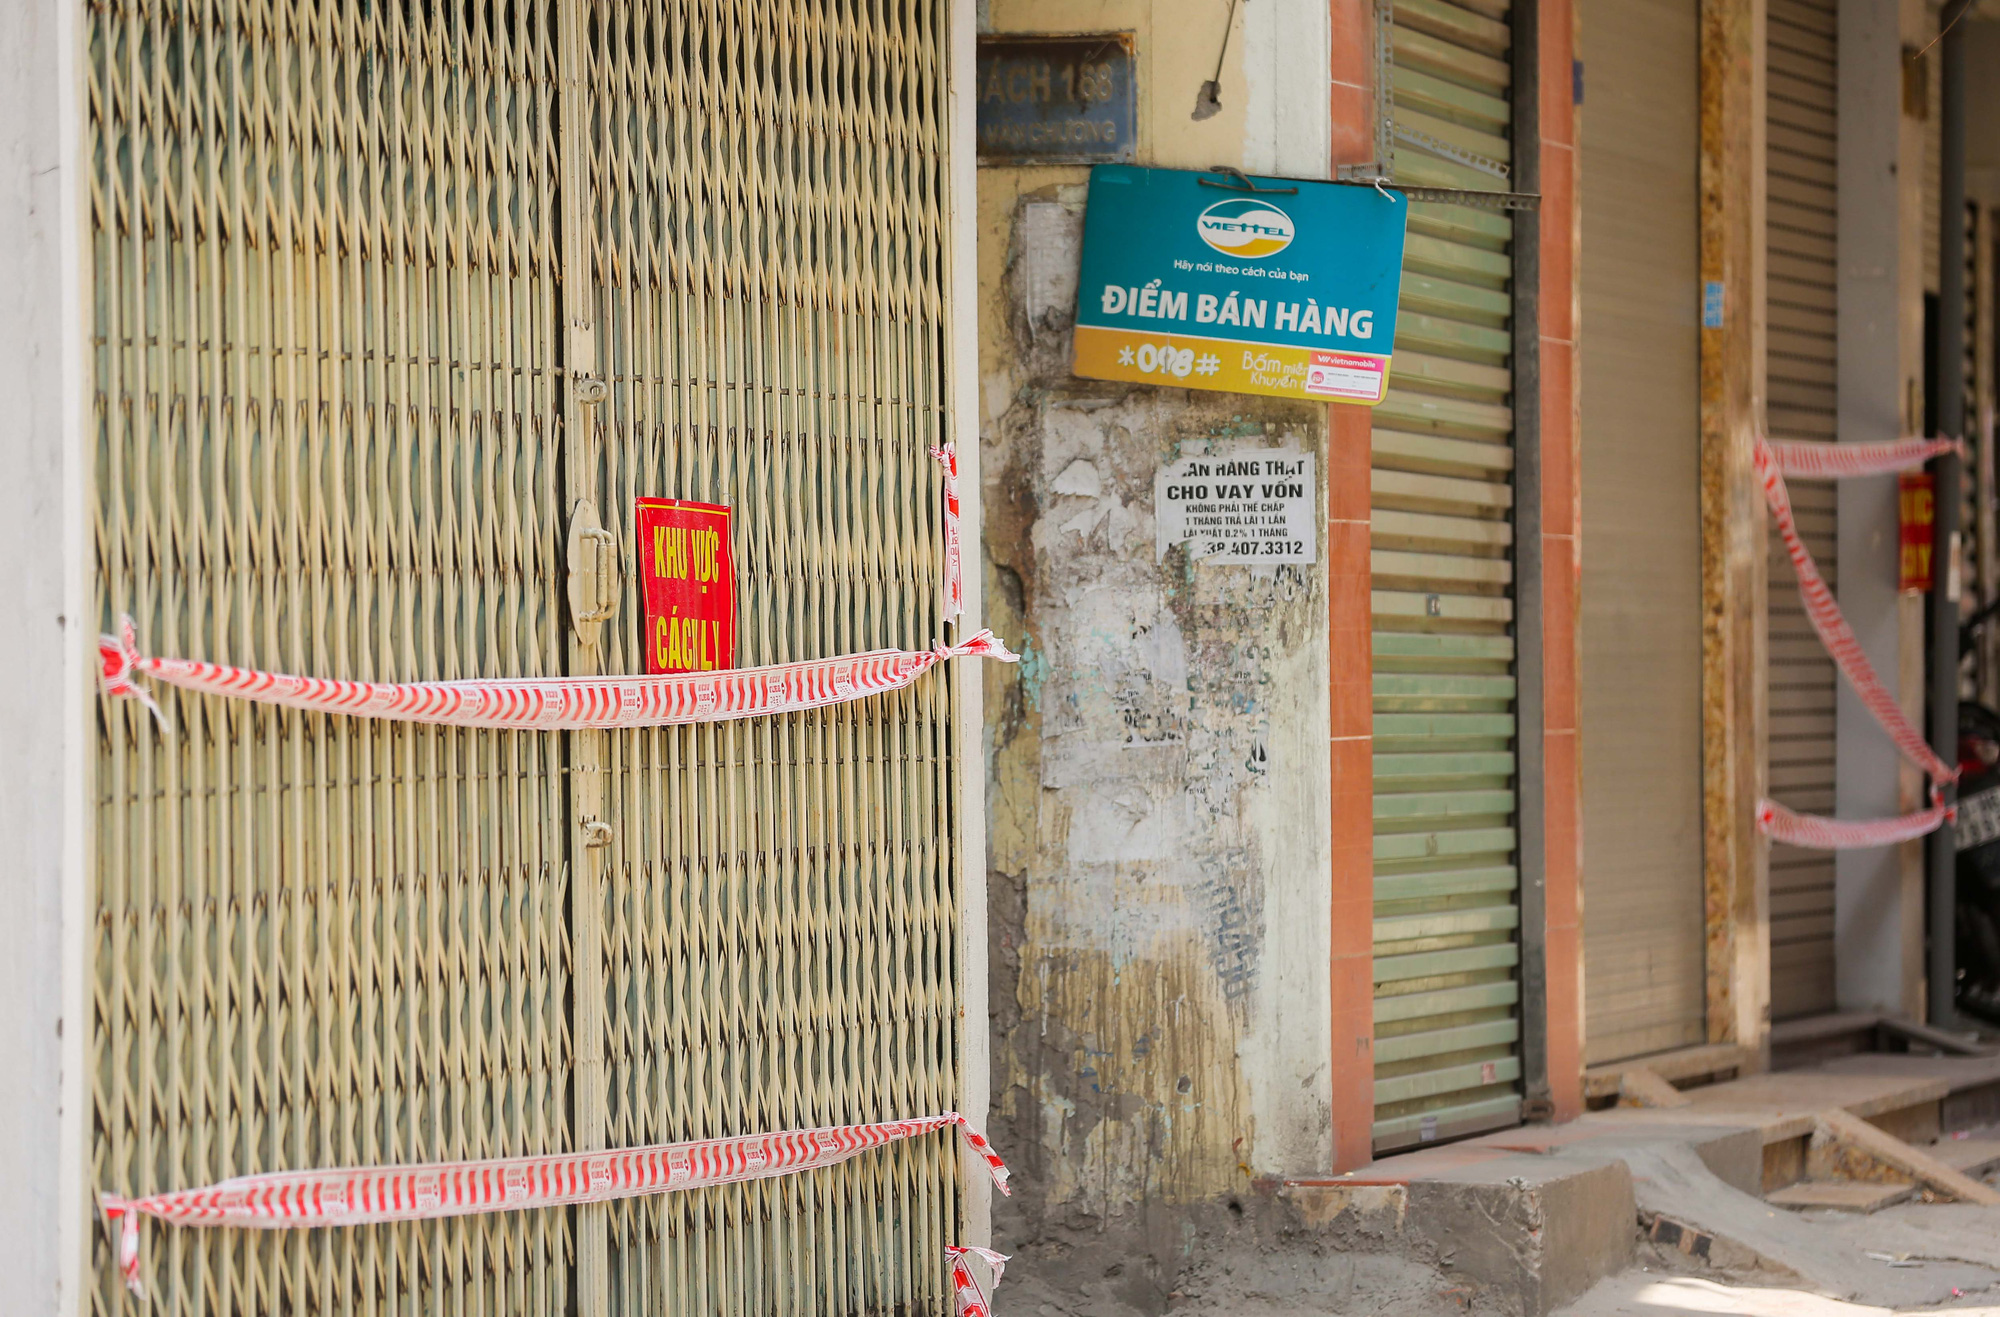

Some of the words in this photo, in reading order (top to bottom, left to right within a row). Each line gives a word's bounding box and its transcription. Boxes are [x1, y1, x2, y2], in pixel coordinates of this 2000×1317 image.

[977, 57, 1049, 103] ÁCH
[1061, 62, 1113, 102] 168
[1196, 261, 1213, 273] nói
[1215, 263, 1240, 275] theo
[1241, 266, 1266, 278] cách
[1268, 267, 1287, 280] của
[1289, 270, 1309, 284] bạn
[1101, 278, 1189, 321] ĐIỂM
[1195, 290, 1268, 329] BÁN
[1274, 297, 1374, 339] HÀNG
[1242, 350, 1281, 373] Bấm
[1250, 371, 1297, 390] Khuyến
[1167, 485, 1209, 500] CHO
[1215, 484, 1255, 499] VAY
[1261, 478, 1304, 499] VỐN
[1186, 502, 1216, 513] KHÔNG
[1218, 501, 1240, 513] PHẢI
[1186, 516, 1190, 525] 1
[1193, 514, 1223, 525] THÁNG
[1225, 512, 1242, 525] TRẢ
[1261, 516, 1265, 525] 1
[1225, 529, 1248, 538] 0.2%
[1251, 529, 1255, 538] 1
[1259, 526, 1289, 537] THÁNG
[653, 525, 688, 580] KHU
[691, 525, 719, 594] VỰC
[700, 619, 720, 670] LY
